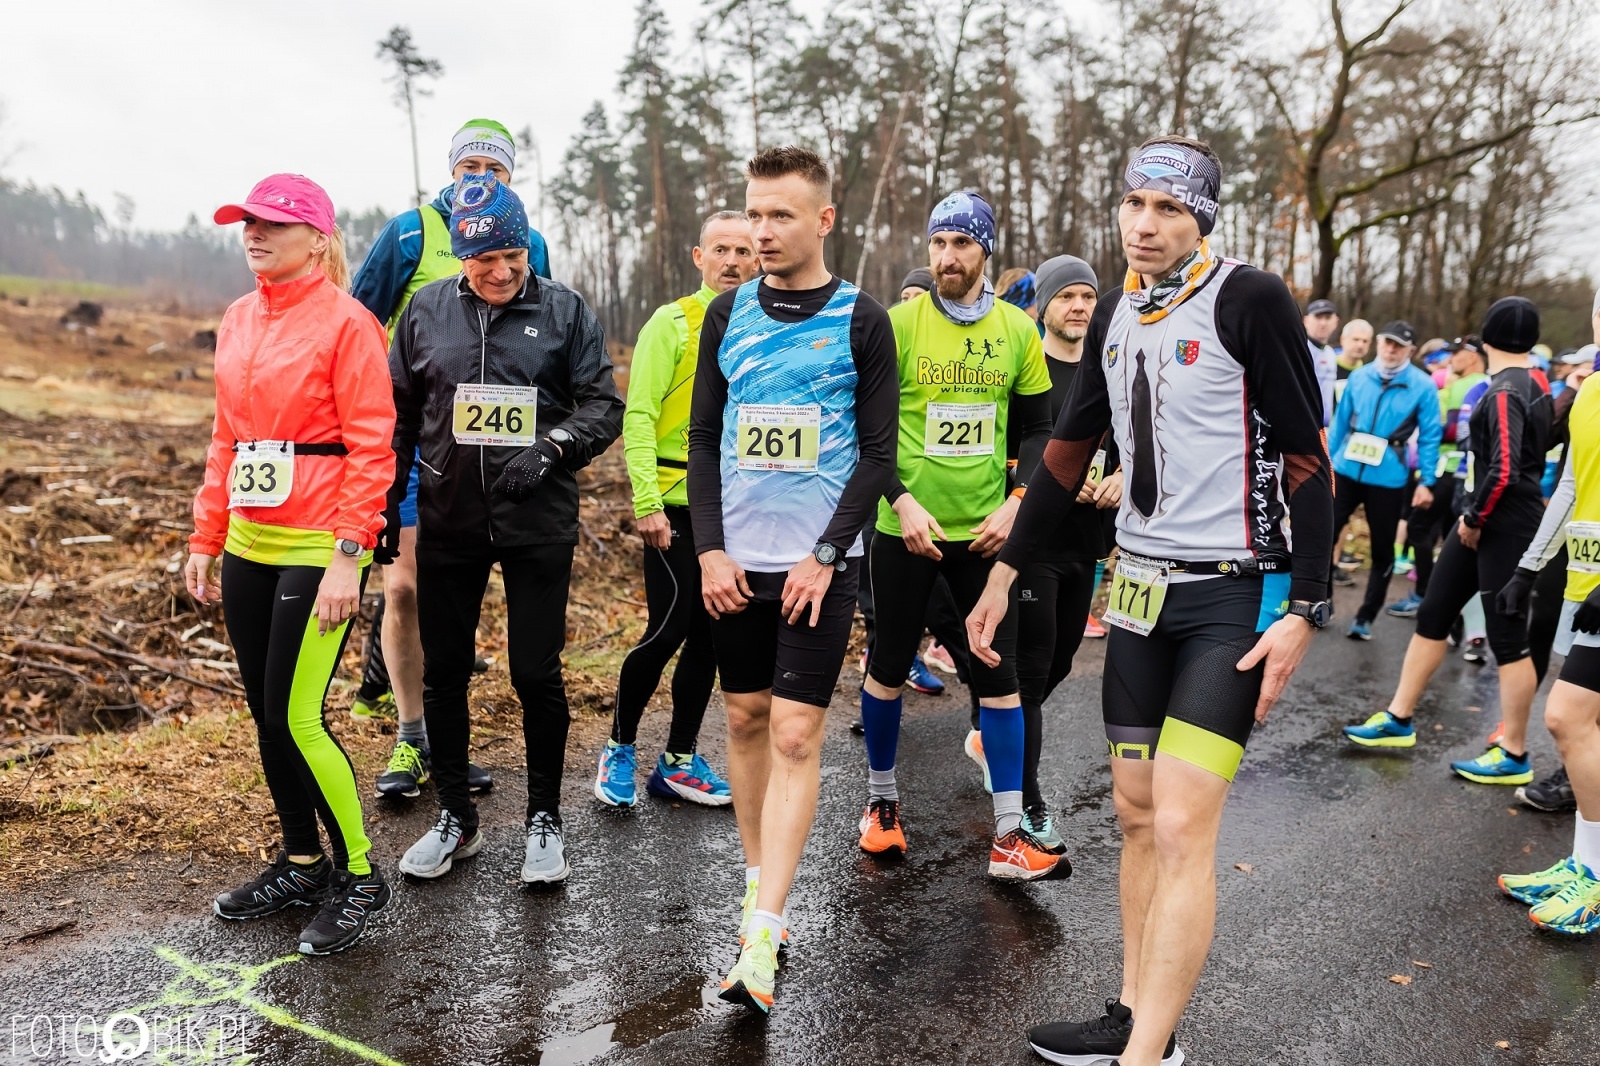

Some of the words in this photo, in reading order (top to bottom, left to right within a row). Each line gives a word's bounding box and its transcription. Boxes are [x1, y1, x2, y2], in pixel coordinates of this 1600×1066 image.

[1133, 156, 1189, 174] ELIMINATOR
[1171, 183, 1219, 214] Super
[917, 356, 1008, 386] Radlinioki
[953, 385, 988, 395] biegu
[466, 405, 522, 433] 246
[937, 420, 982, 445] 221
[746, 427, 801, 458] 261
[1572, 538, 1600, 562] 242
[1118, 578, 1152, 619] 171
